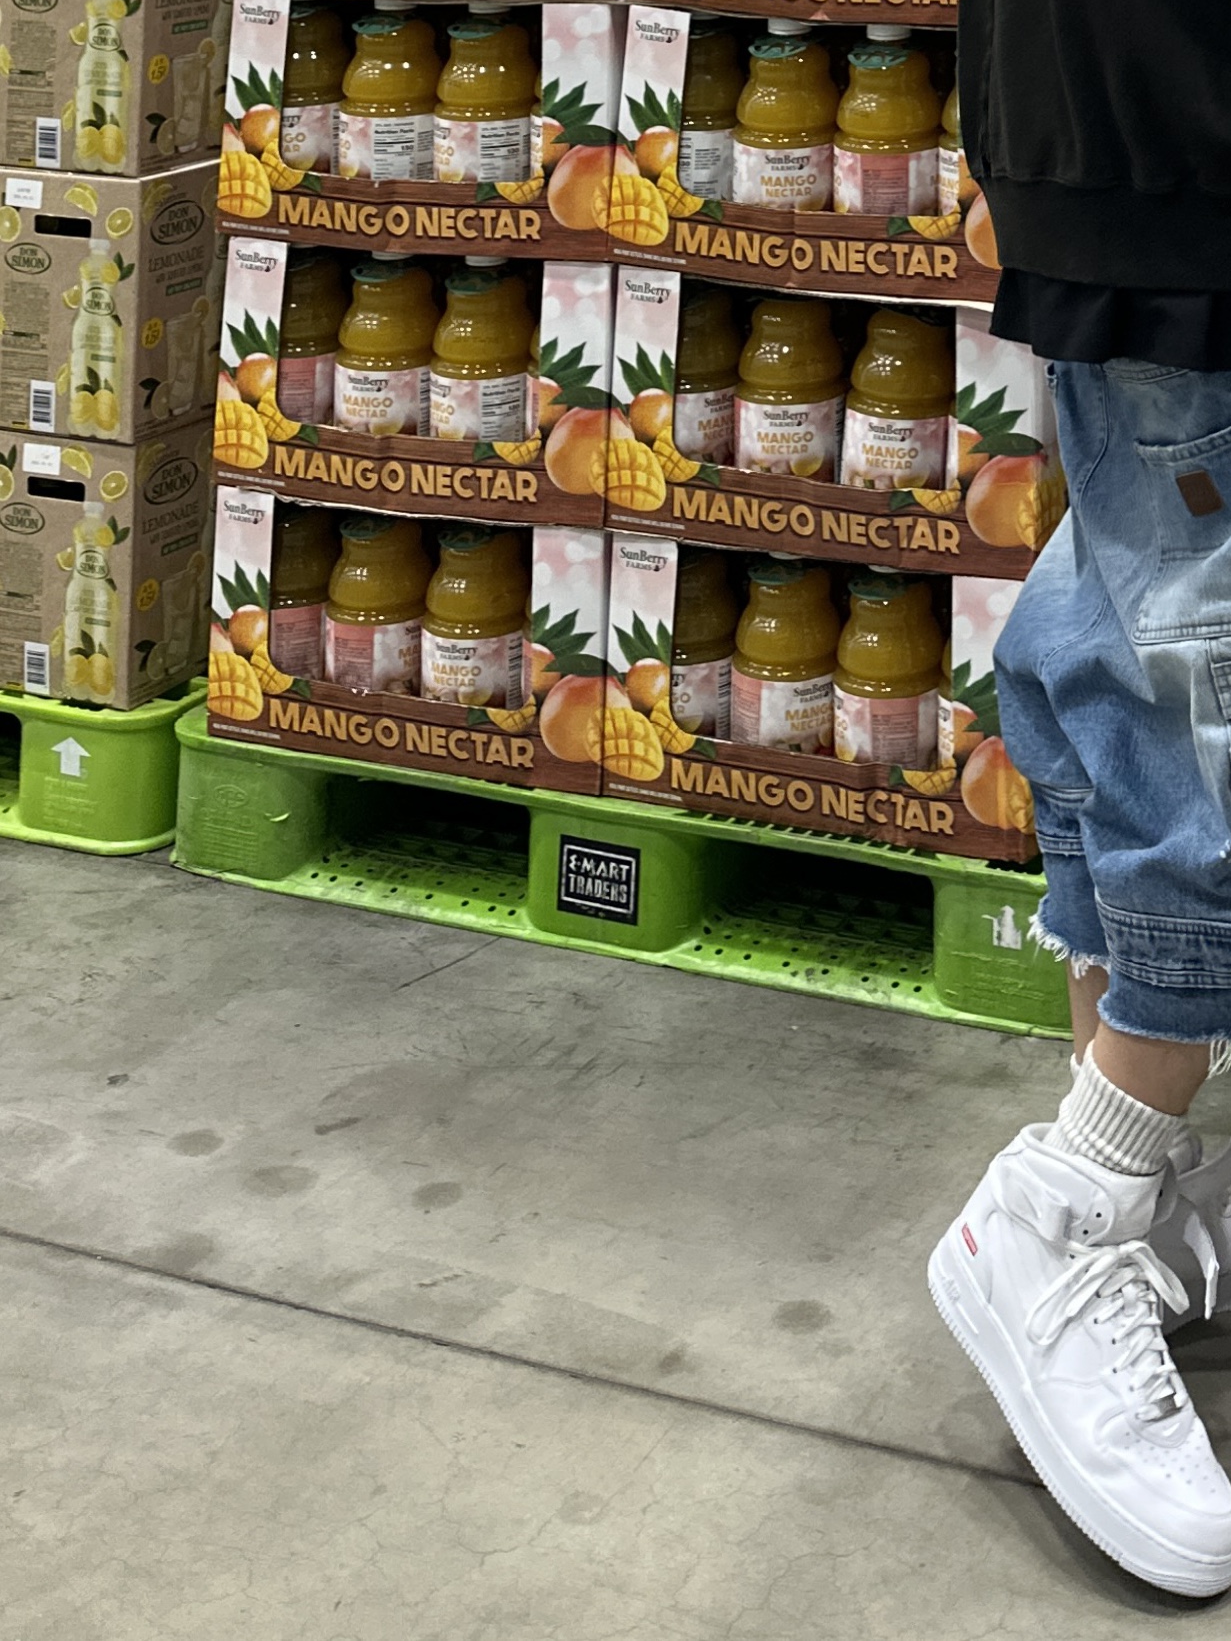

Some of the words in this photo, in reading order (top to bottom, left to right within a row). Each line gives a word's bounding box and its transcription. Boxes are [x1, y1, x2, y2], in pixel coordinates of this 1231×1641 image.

[239, 3, 281, 20] SunBerry
[635, 20, 680, 38] SunBerry
[760, 175, 817, 185] MANGO
[765, 188, 812, 198] NECTAR
[278, 195, 410, 236] MANGO
[415, 208, 541, 240] NECTAR
[235, 250, 278, 265] SunBerry
[674, 222, 813, 269] MANGO
[820, 240, 958, 278] NECTAR
[624, 280, 672, 297] SunBerry
[343, 395, 393, 407] MANGO
[346, 408, 388, 418] NECTAR
[757, 431, 814, 443] MANGO
[761, 443, 808, 455] NECTAR
[862, 443, 919, 458] MANGO
[866, 456, 912, 470] NECTAR
[274, 446, 405, 492] MANGO
[411, 465, 538, 502] NECTAR
[224, 501, 266, 519] SunBerry
[672, 488, 815, 536] MANGO
[822, 512, 960, 554] NECTAR
[619, 546, 668, 566] SunBerry
[431, 663, 482, 677] MANGO
[434, 675, 476, 687] NECTAR
[269, 698, 399, 747] MANGO
[406, 724, 534, 767] NECTAR
[671, 759, 813, 811] MANGO
[822, 788, 955, 835] NECTAR
[568, 874, 627, 902] TRADERS
